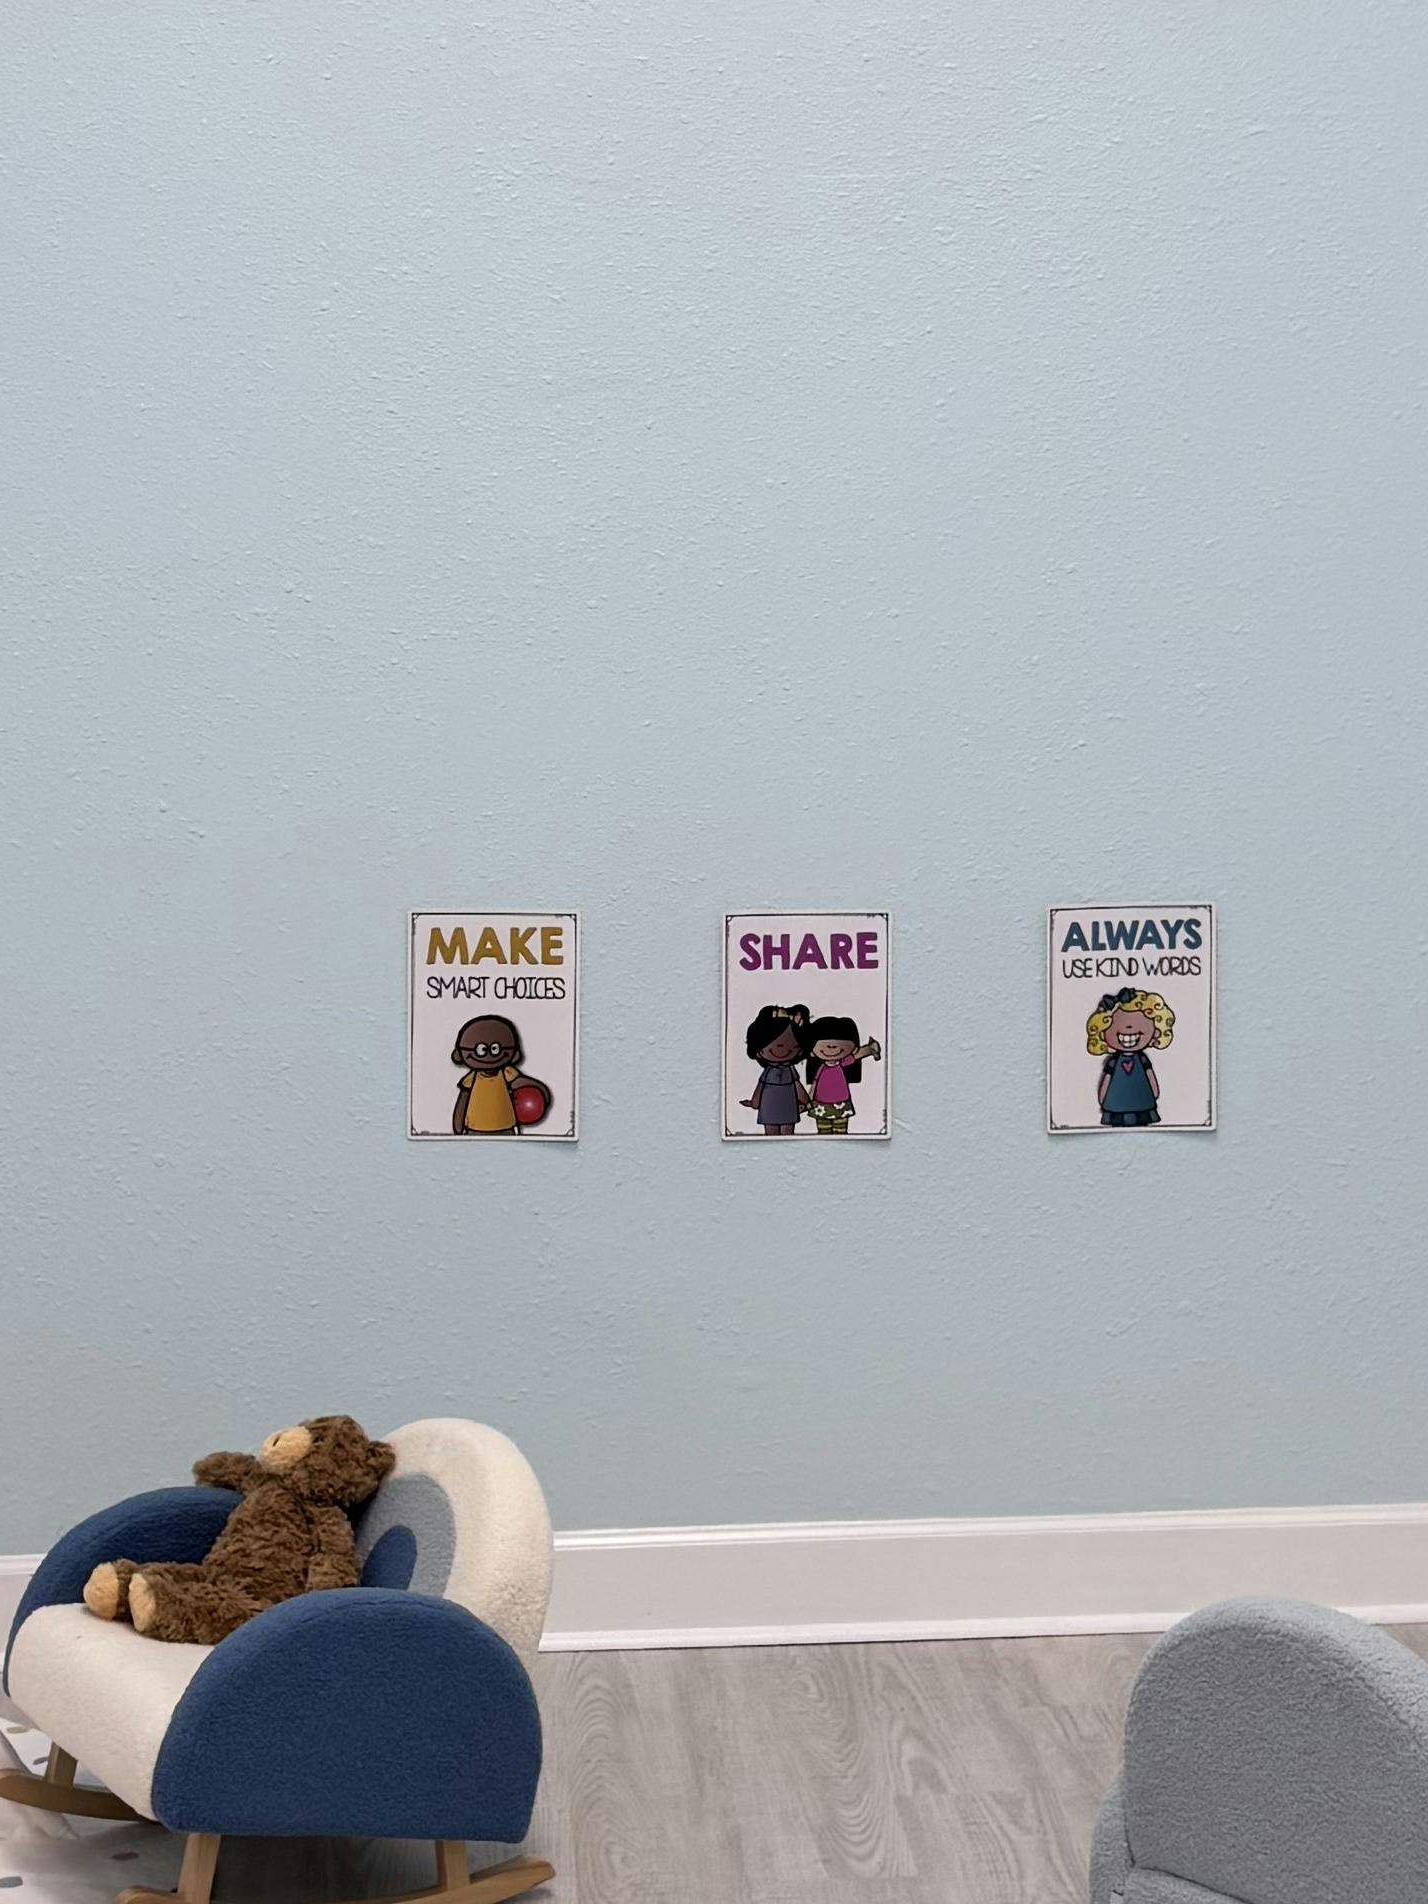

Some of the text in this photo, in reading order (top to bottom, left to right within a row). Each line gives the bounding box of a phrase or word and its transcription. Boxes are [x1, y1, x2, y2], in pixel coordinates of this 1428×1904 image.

[426, 927, 564, 965] MAKE
[739, 932, 879, 971] SHARE
[1061, 918, 1203, 952] ALWAYS
[1062, 956, 1202, 979] USE KIND WORDS
[426, 976, 566, 999] SMART CHOICES
